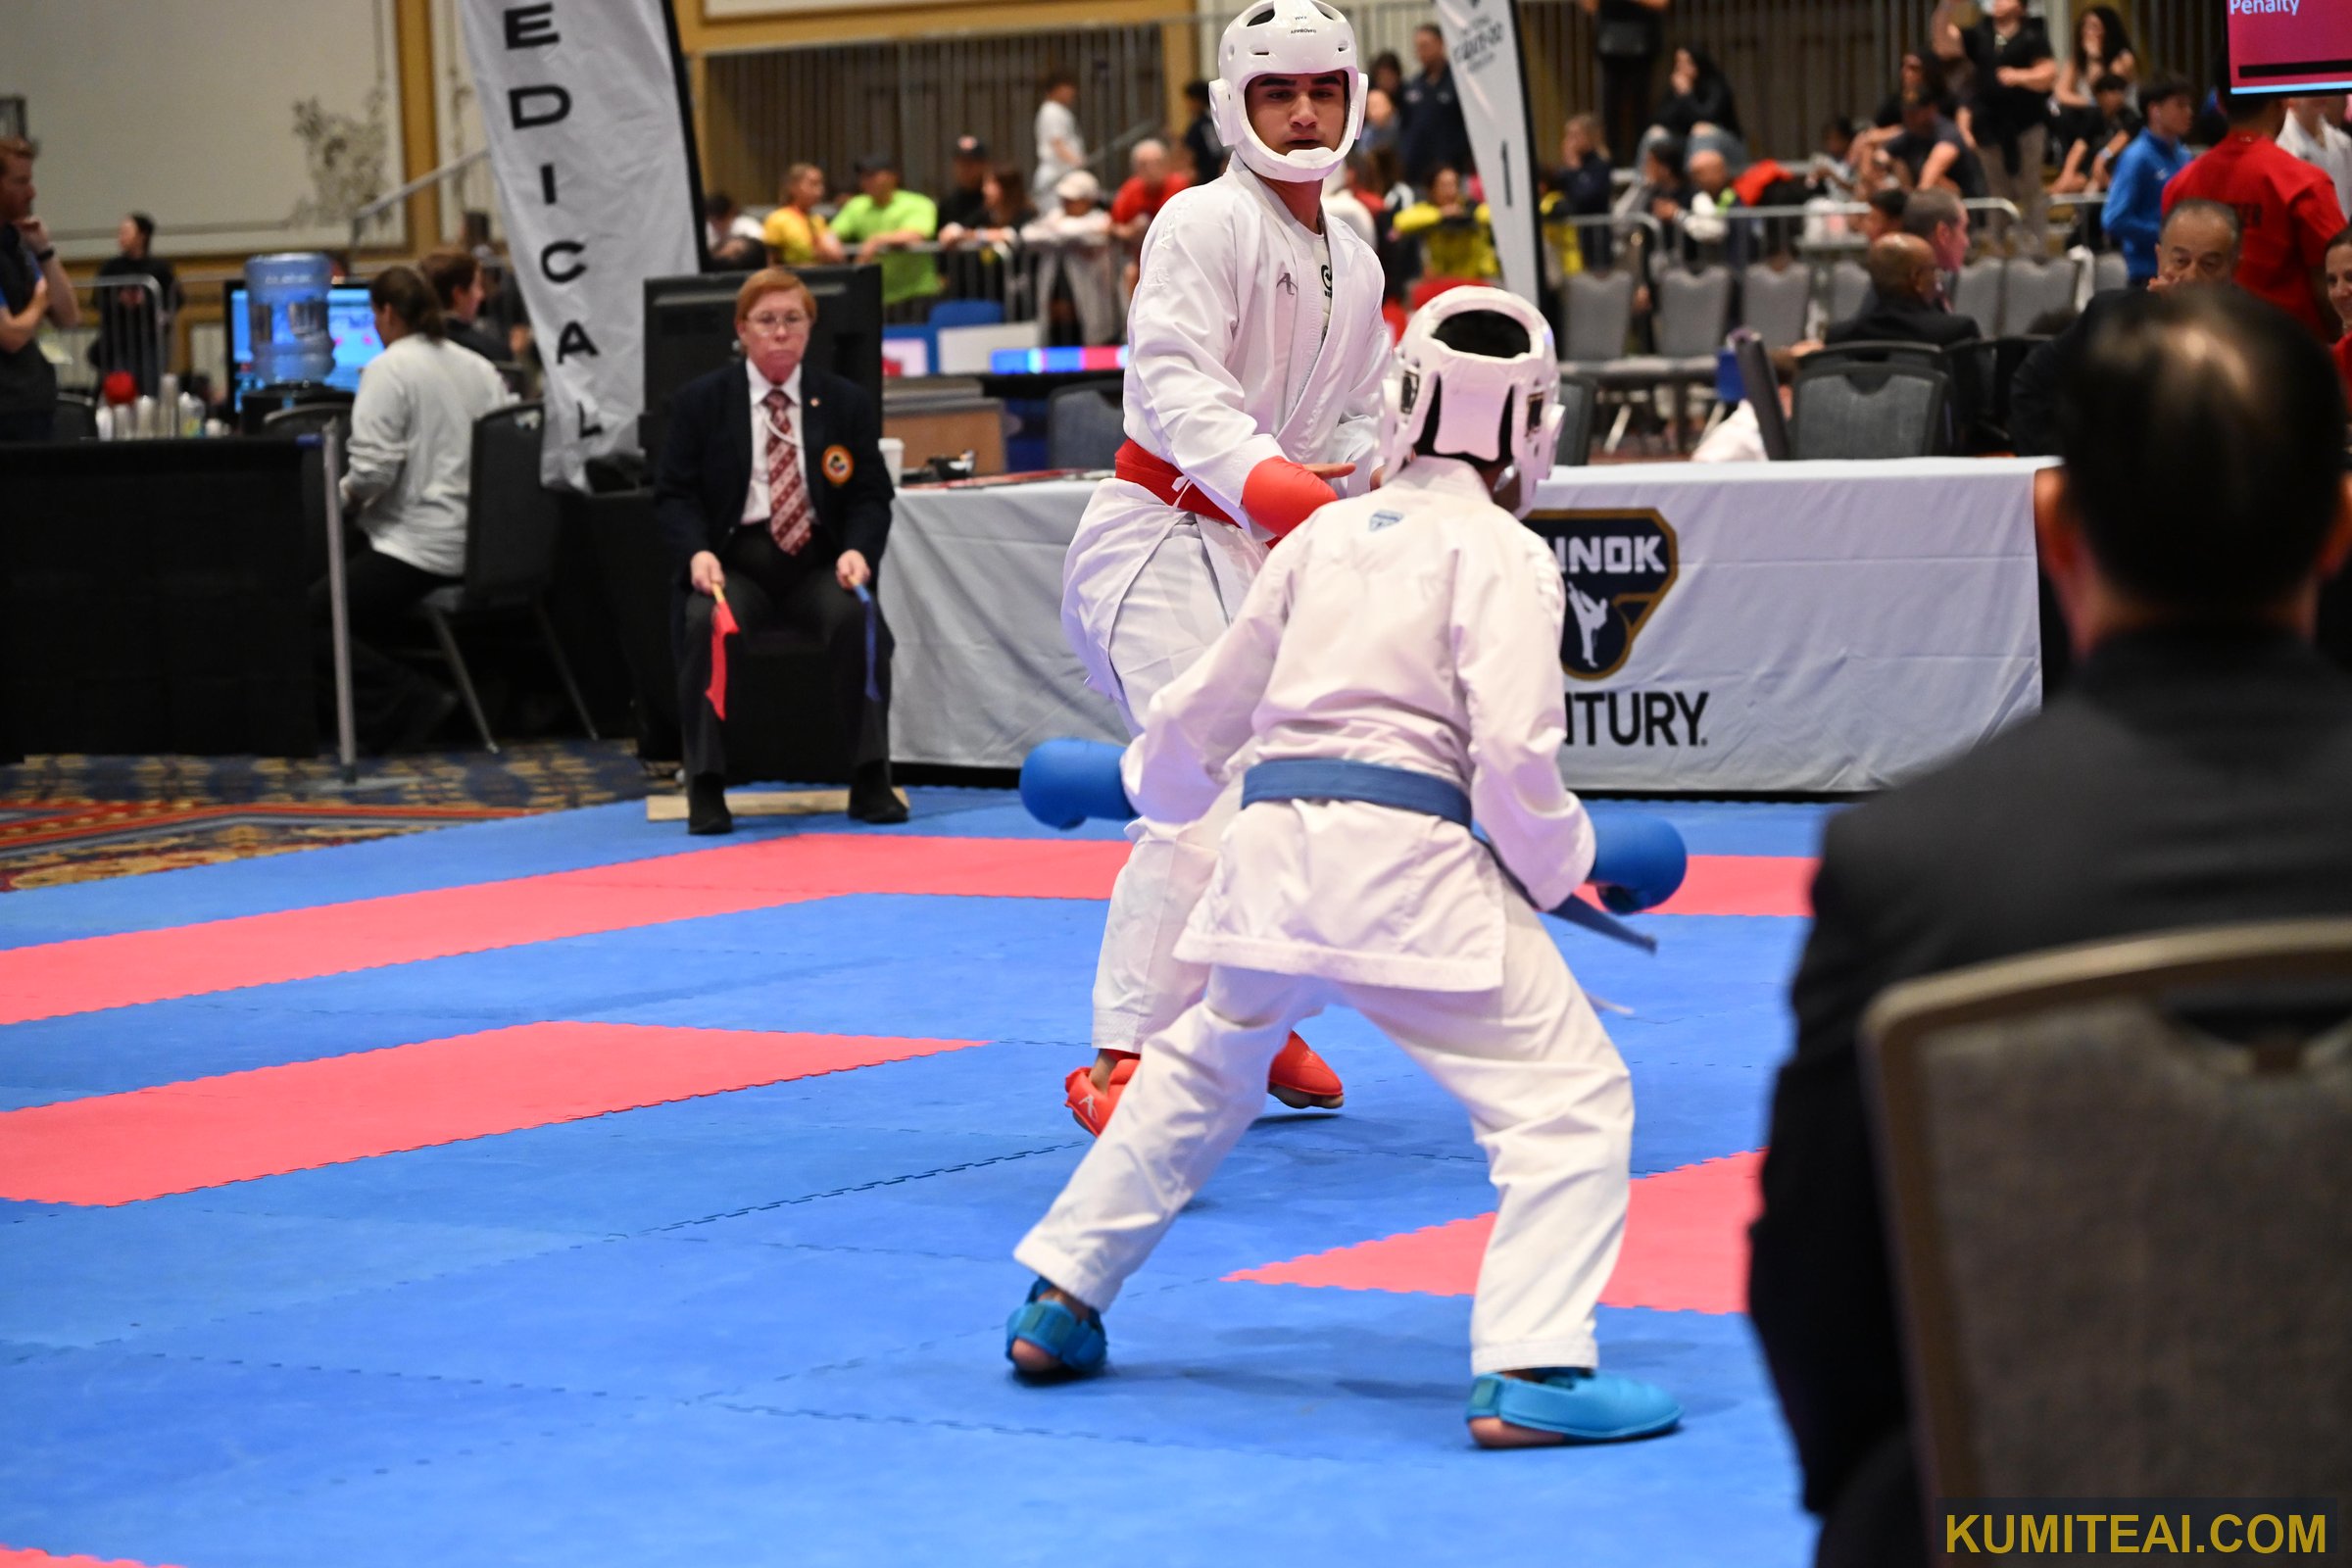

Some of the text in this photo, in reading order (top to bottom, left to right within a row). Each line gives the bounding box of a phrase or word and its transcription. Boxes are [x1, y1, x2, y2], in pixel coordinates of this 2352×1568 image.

[2230, 0, 2300, 16] Penalty
[503, 2, 602, 439] EDICAL
[1553, 535, 1667, 573] NOK
[1564, 691, 1709, 747] TURY
